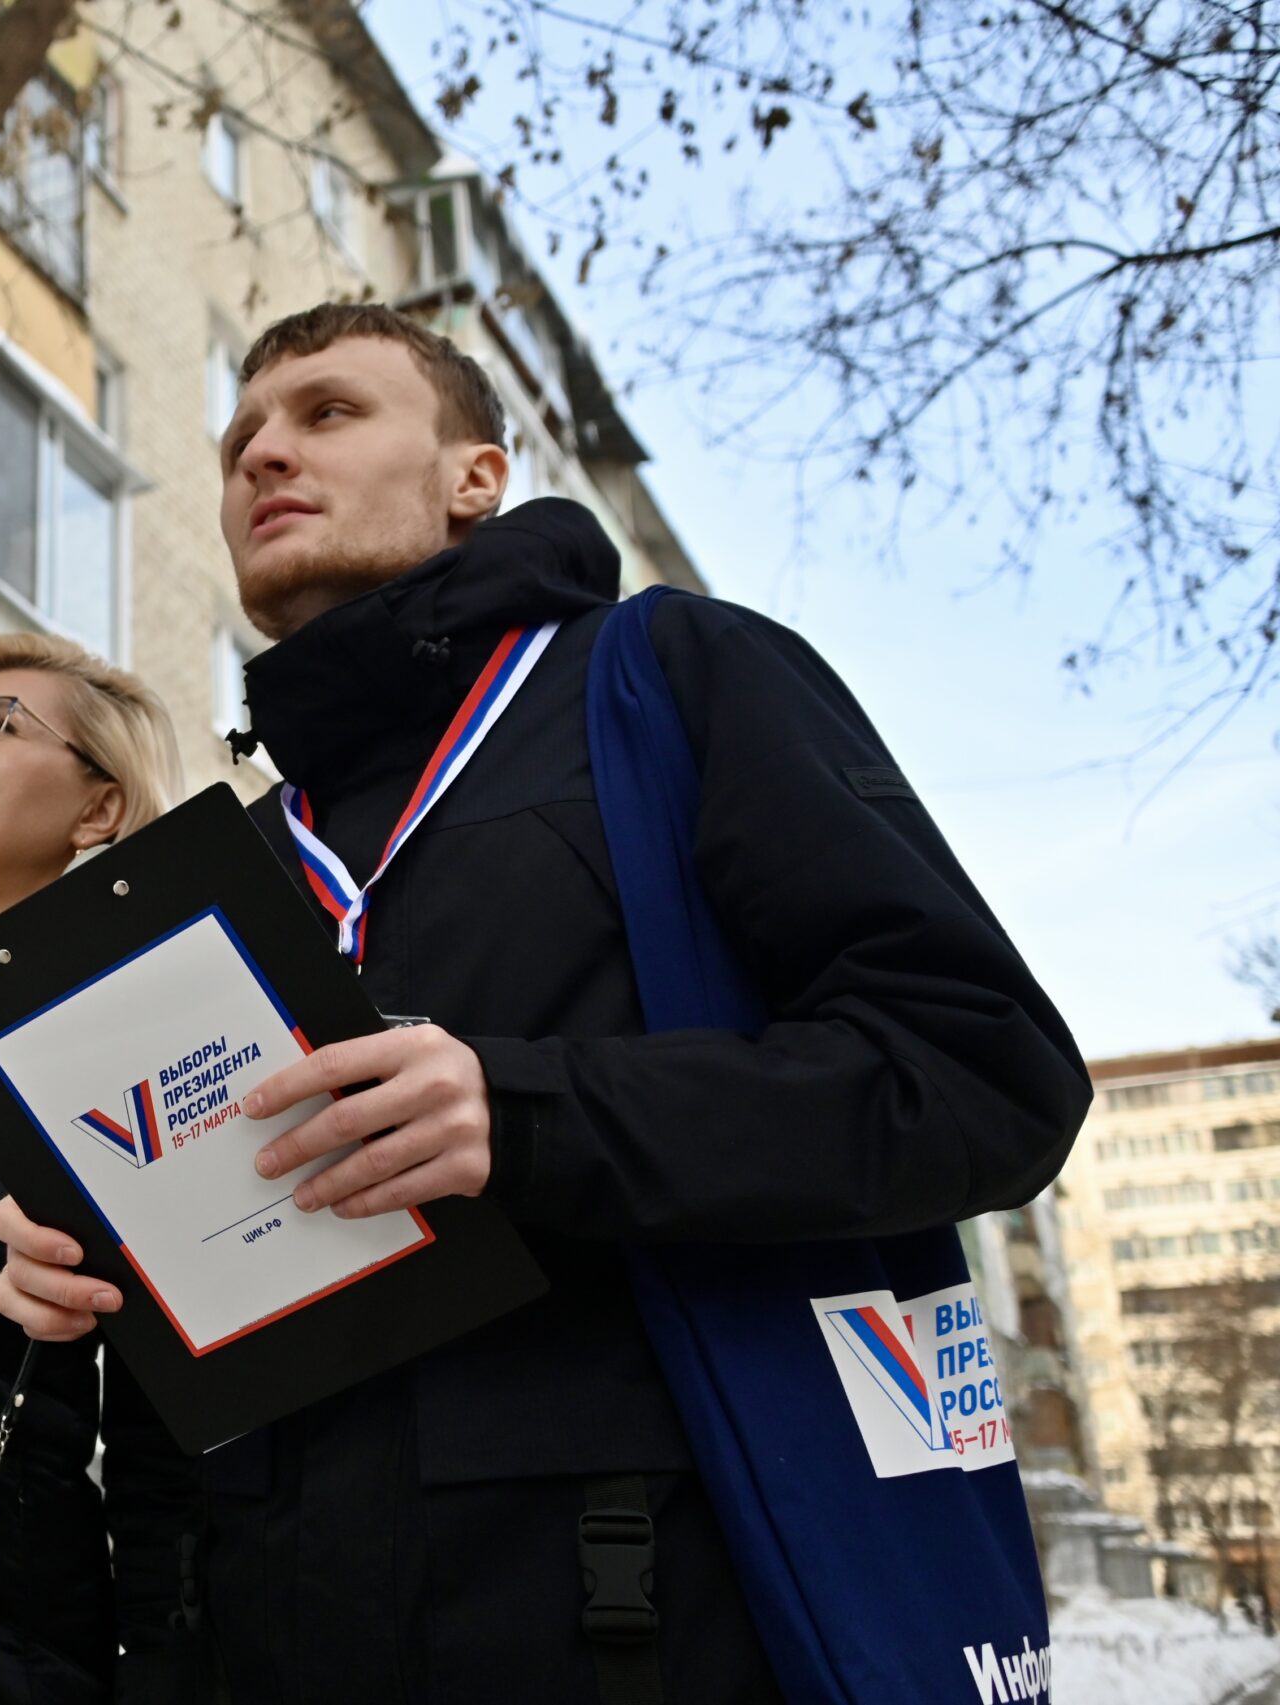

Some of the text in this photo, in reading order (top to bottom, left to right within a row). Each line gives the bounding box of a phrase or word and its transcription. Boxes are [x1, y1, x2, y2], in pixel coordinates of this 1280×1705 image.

[158, 1035, 228, 1087] ВЫБОРЫ
[162, 1042, 262, 1110] ПРЕЗИДЕНТА
[167, 1084, 229, 1131] РОССИИ
[203, 1101, 241, 1133] МАРТА
[242, 1218, 282, 1244] ЦИК.РФ
